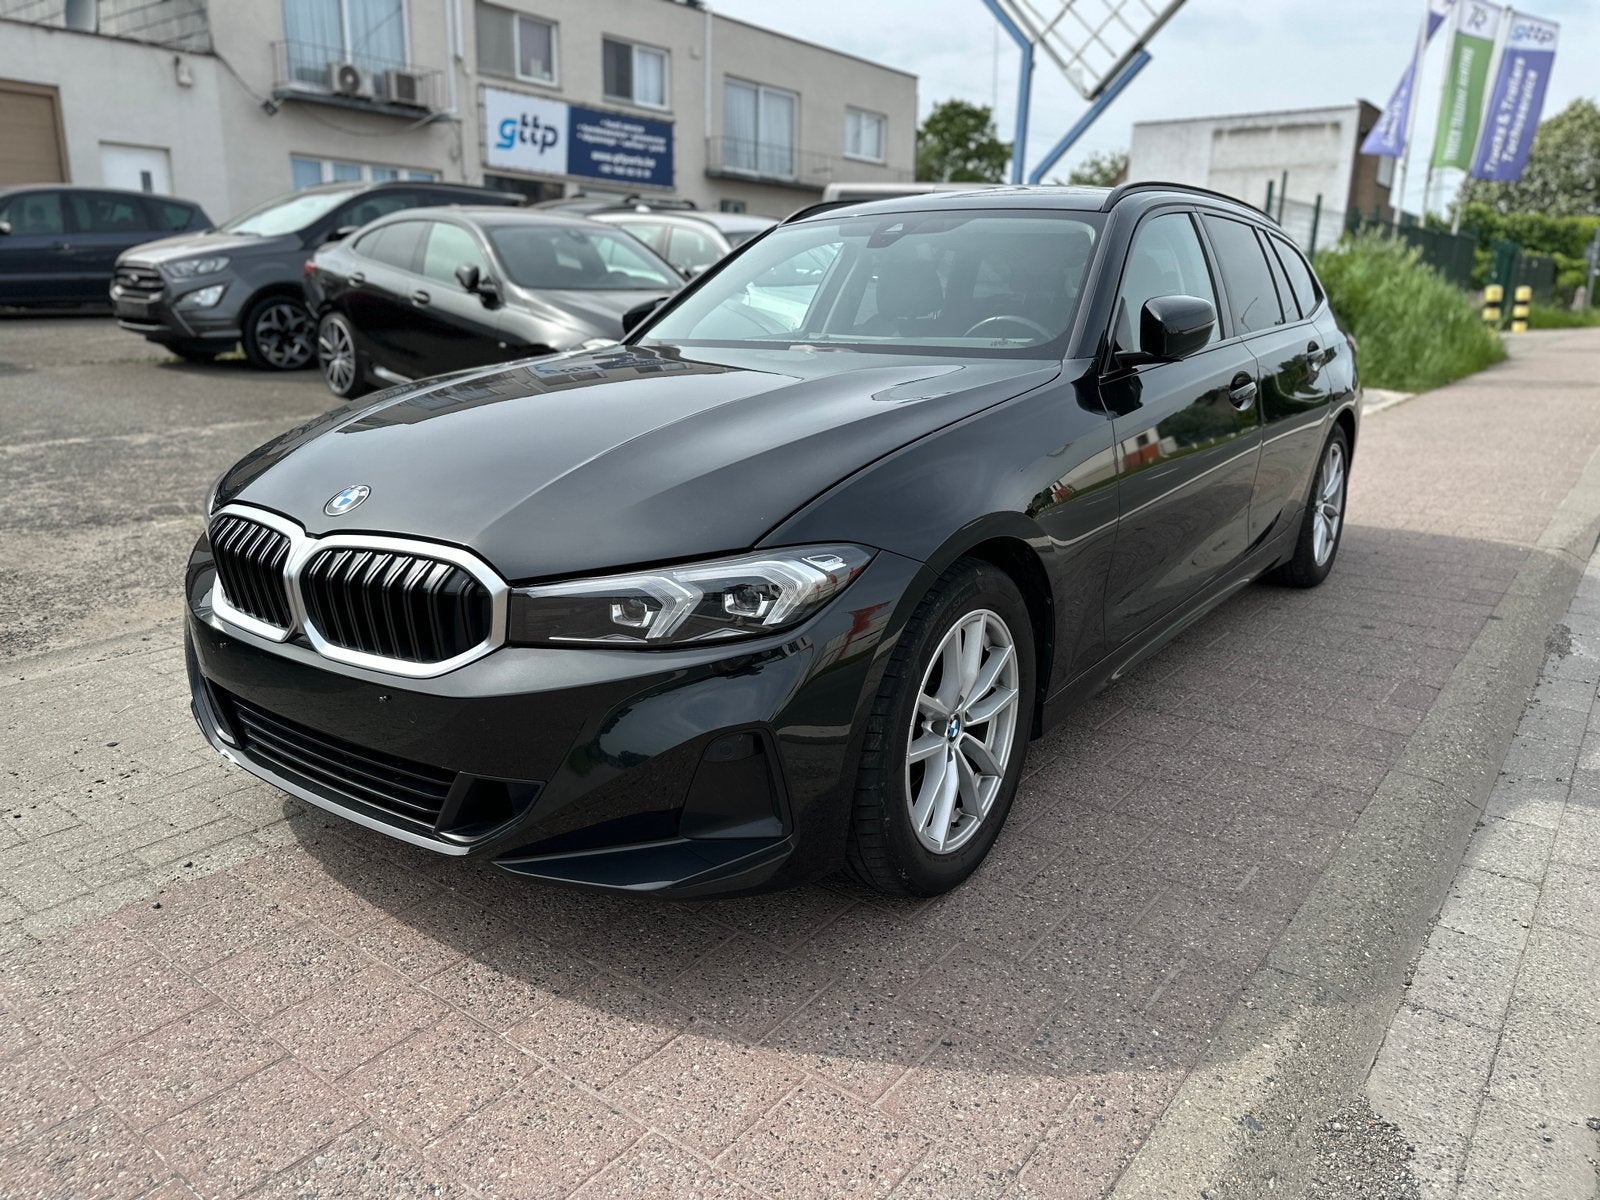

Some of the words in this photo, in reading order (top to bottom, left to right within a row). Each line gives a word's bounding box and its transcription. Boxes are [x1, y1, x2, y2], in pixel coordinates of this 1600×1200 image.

[495, 112, 559, 155] gttp
[1484, 126, 1506, 174] Trucks
[1501, 56, 1526, 111] Trailers
